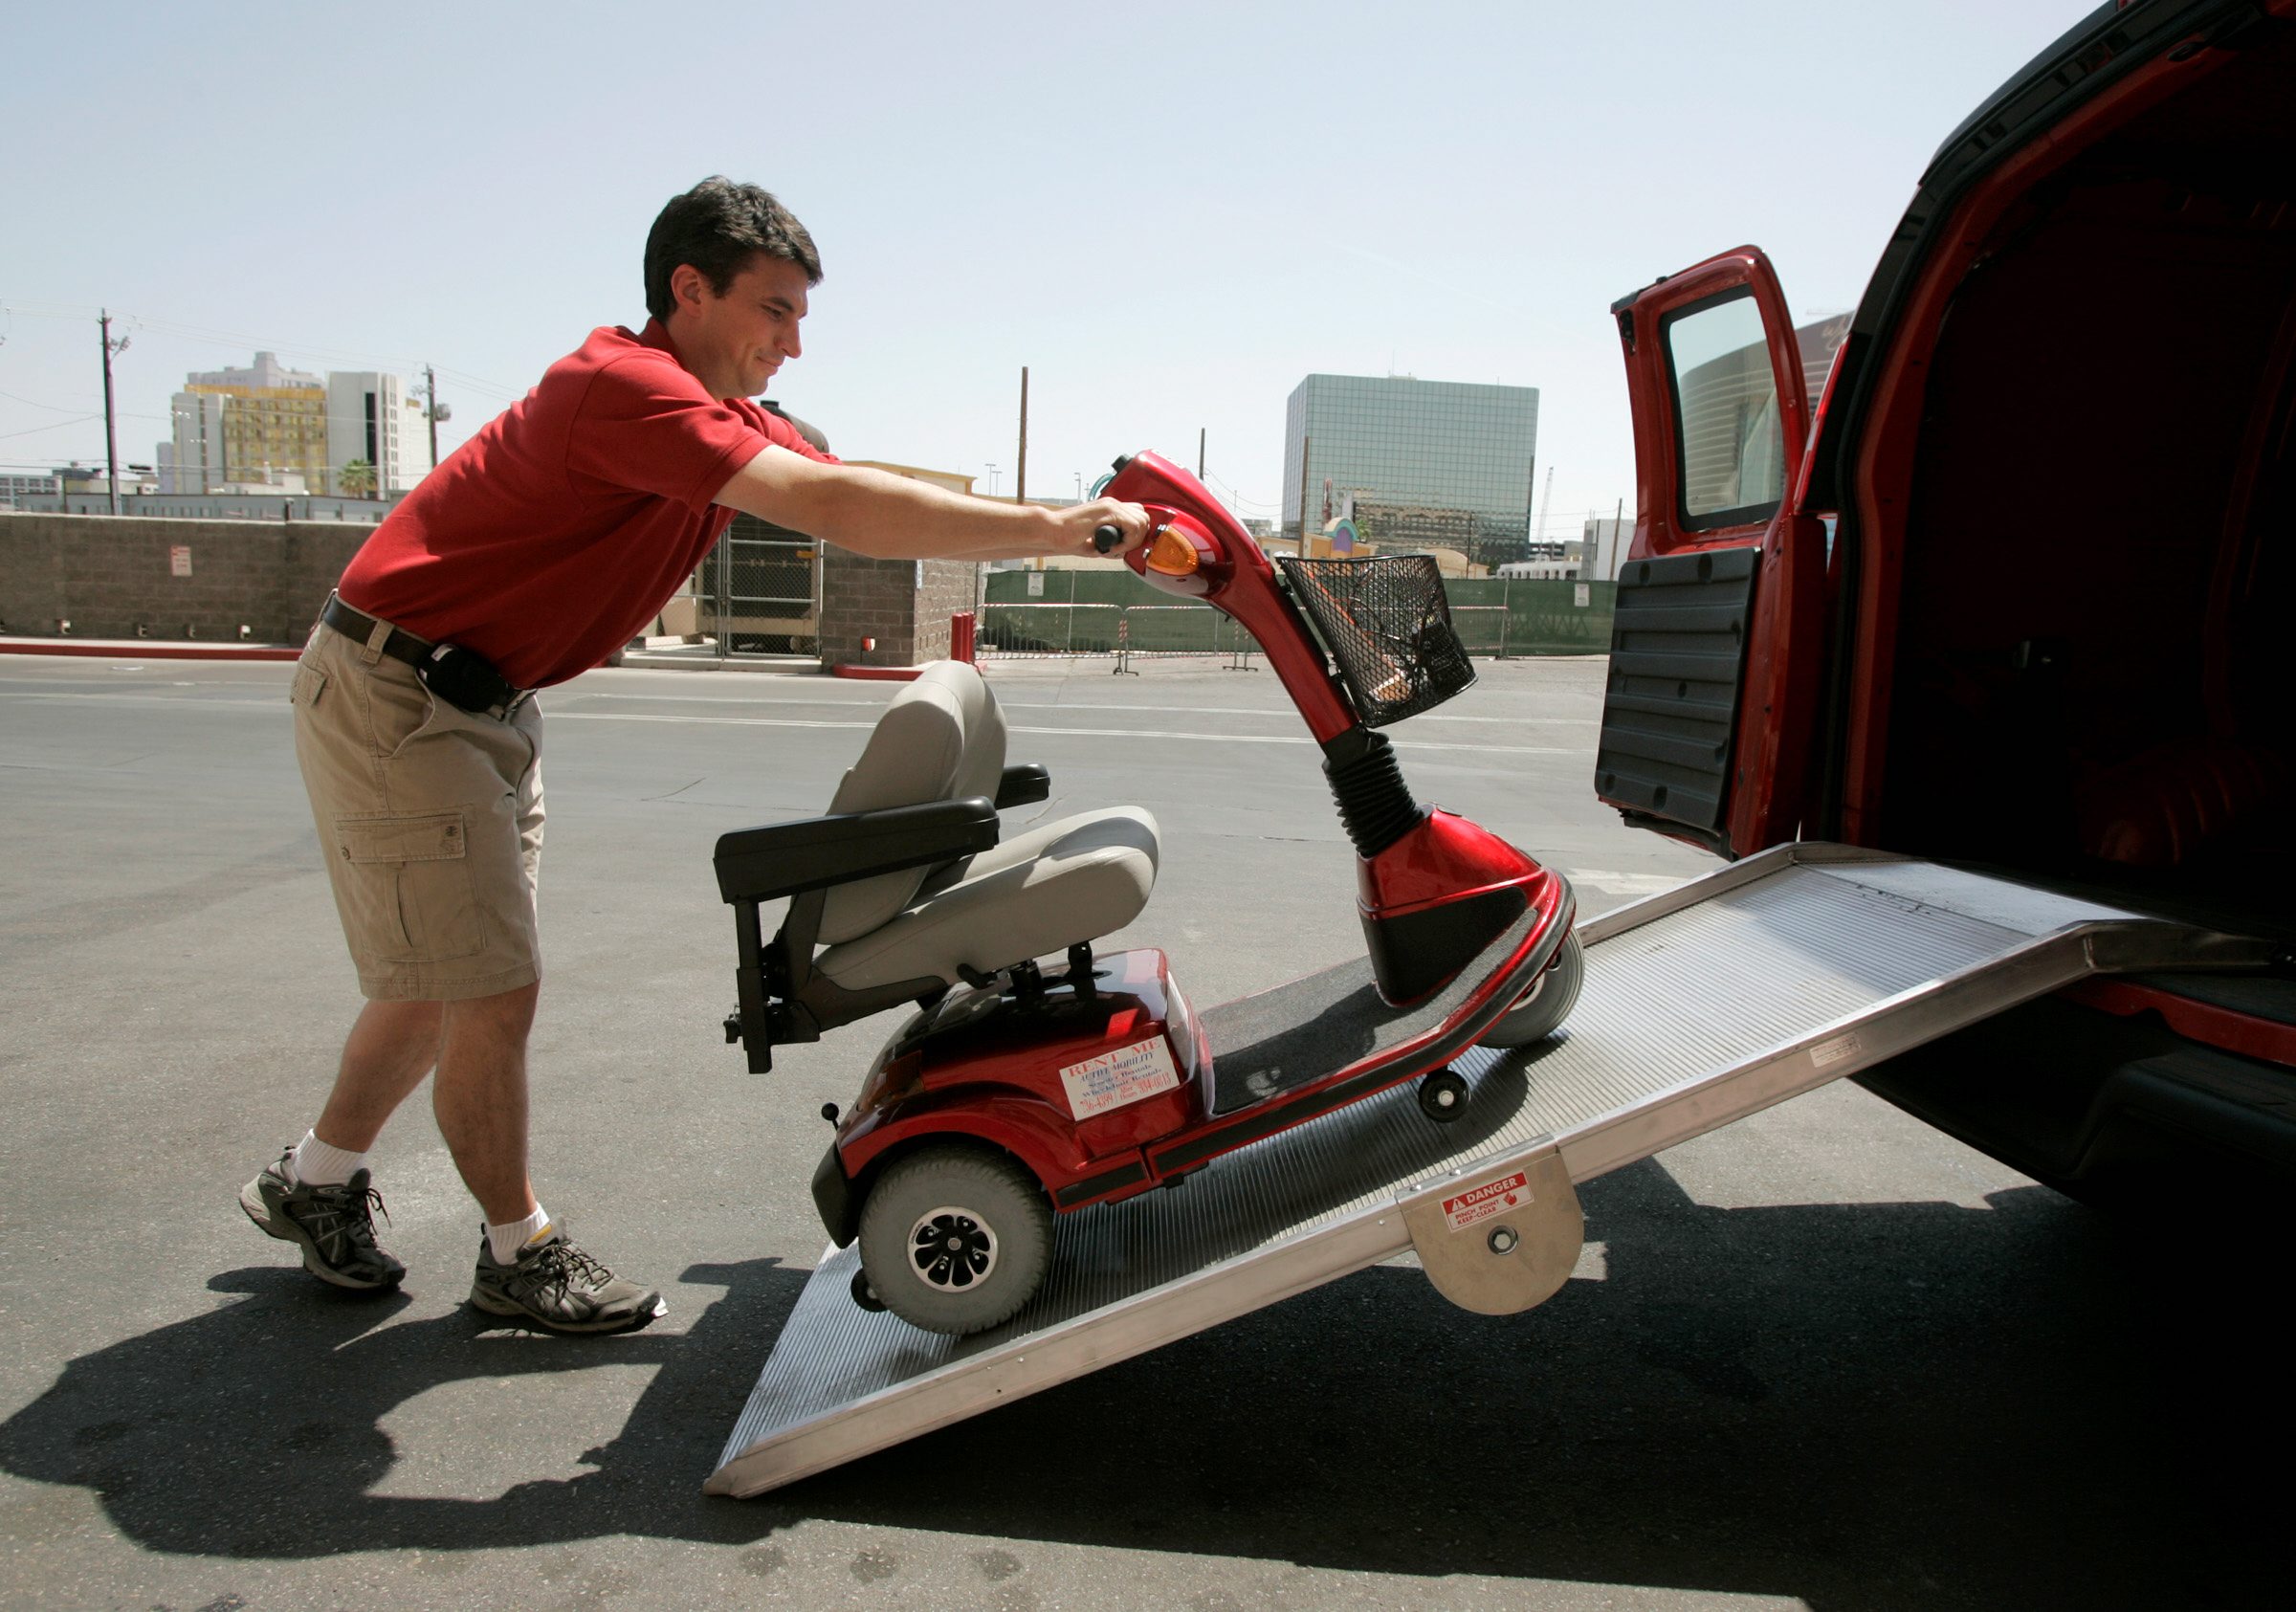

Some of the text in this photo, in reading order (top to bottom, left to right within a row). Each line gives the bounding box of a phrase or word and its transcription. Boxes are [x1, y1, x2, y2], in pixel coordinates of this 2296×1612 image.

[1069, 1039, 1160, 1077] RENT ME
[1080, 1052, 1154, 1081] ACTIVE MOBILITY
[1466, 1178, 1517, 1203] DANGER
[1456, 1199, 1499, 1219] PINCH POINT
